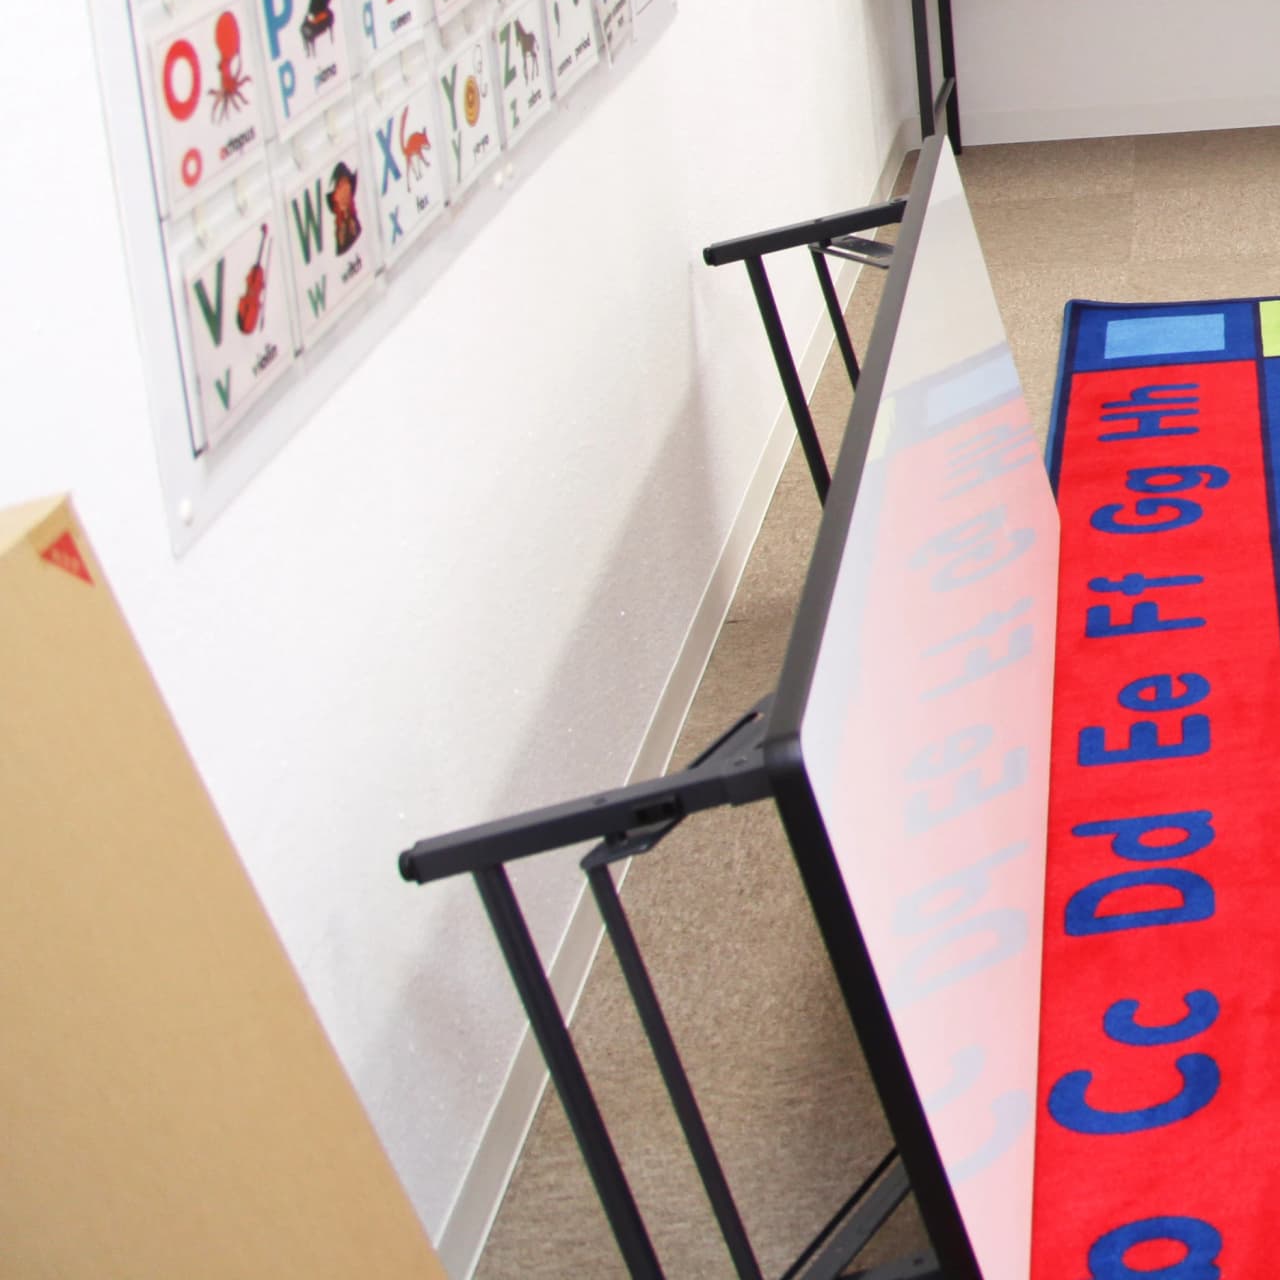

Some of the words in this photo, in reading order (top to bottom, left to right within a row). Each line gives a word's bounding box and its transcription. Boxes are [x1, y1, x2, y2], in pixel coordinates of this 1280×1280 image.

[363, 0, 376, 48] q
[499, 22, 516, 89] Z
[163, 39, 202, 122] O
[278, 60, 296, 119] p
[441, 63, 458, 131] Y
[511, 98, 520, 128] z
[181, 147, 203, 188] o
[376, 116, 402, 195] X
[452, 130, 461, 184] y
[292, 178, 323, 265] W
[389, 204, 403, 245] x
[194, 257, 225, 348] V
[308, 274, 326, 318] w
[215, 368, 231, 411] v
[1101, 384, 1197, 440] Hh
[1092, 466, 1229, 533] Gg
[1087, 574, 1204, 637] Ff
[1079, 674, 1210, 765] Ee
[1066, 811, 1214, 935] Dd
[1049, 991, 1219, 1133] Cc
